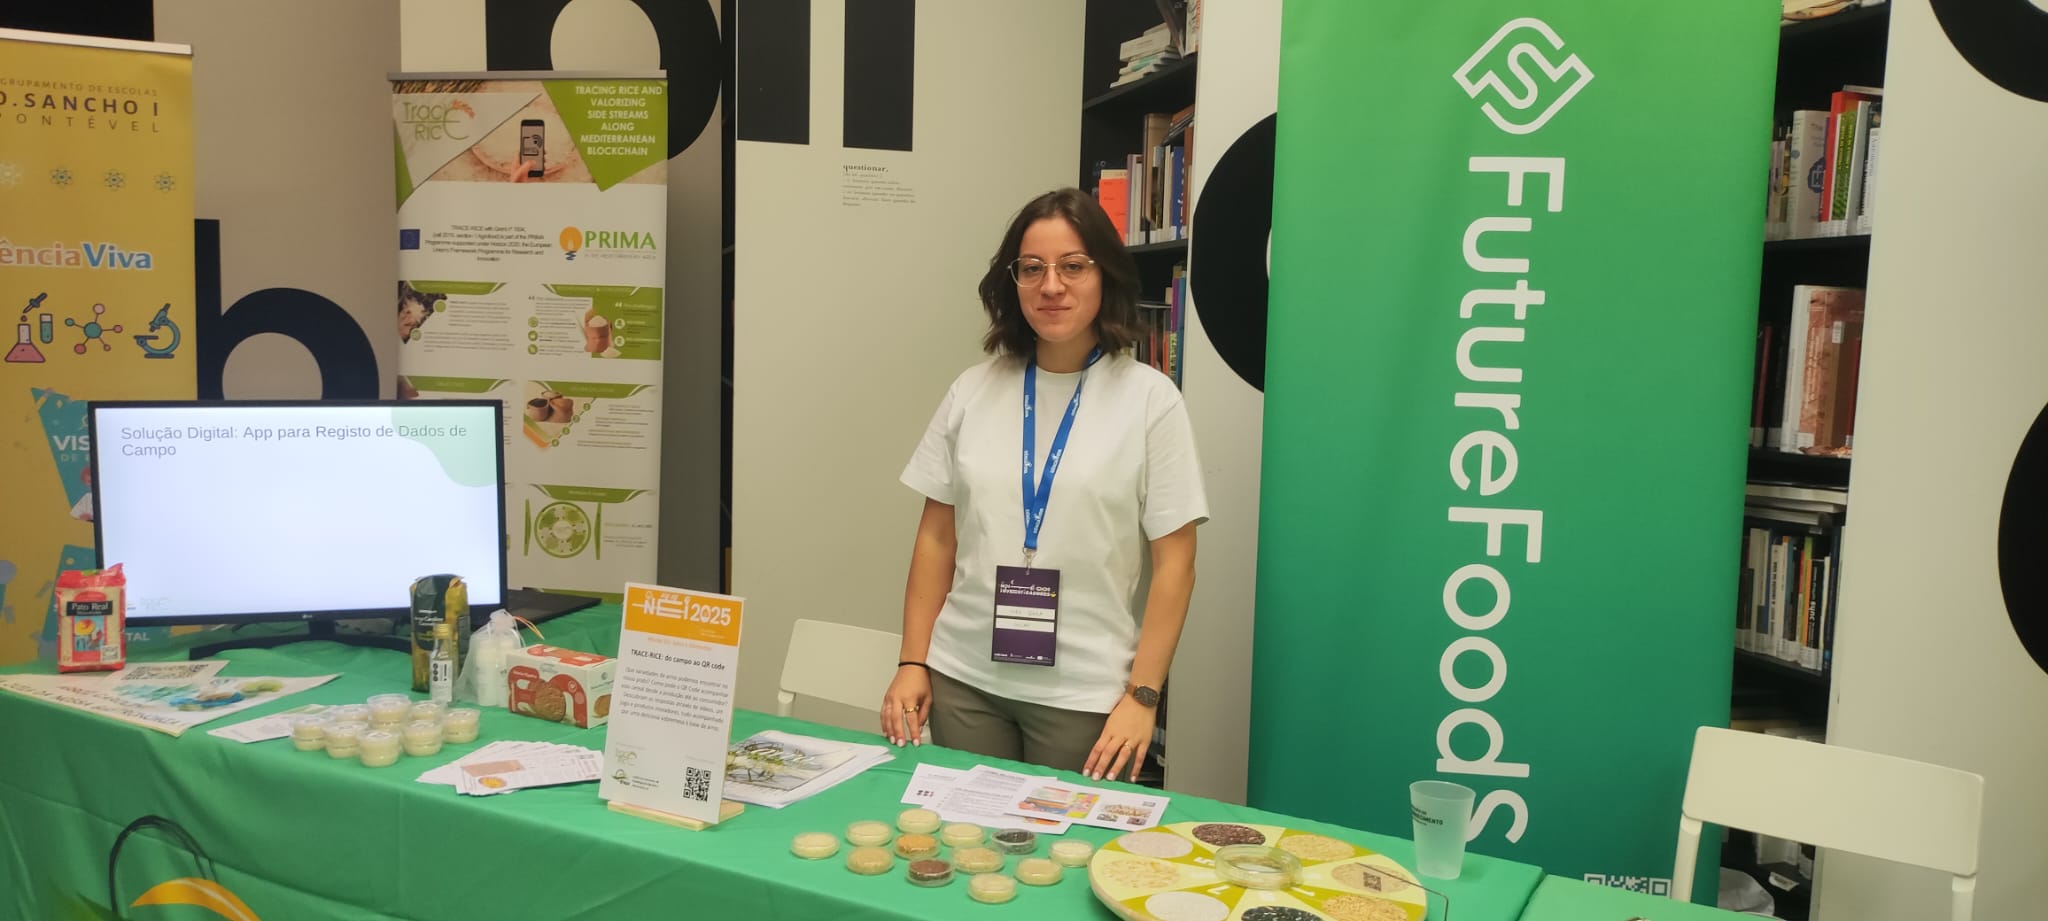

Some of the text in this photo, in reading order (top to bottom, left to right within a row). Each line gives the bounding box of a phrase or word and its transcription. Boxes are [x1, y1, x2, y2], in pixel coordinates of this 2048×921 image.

[87, 84, 102, 93] DE
[107, 86, 158, 97] ESCOLAS
[576, 87, 662, 95] TRACING RICE AND
[591, 98, 646, 107] VALORIZING
[587, 110, 648, 119] SIDE STREAMS
[0, 111, 159, 133] ONTÉVEL
[601, 122, 635, 131] ALONG
[580, 135, 656, 143] MEDITERRANEAN
[587, 147, 648, 155] BLOCKCHAIN
[843, 164, 889, 173] questionar,
[584, 230, 657, 250] PRIMA
[121, 424, 467, 442] Solução Digital: App para Registo de Dados de
[121, 443, 177, 458] Campo
[1435, 156, 1567, 849] FutureFoods
[664, 654, 673, 662] do
[673, 656, 692, 667] campo
[701, 660, 711, 669] QR
[711, 662, 725, 671] code
